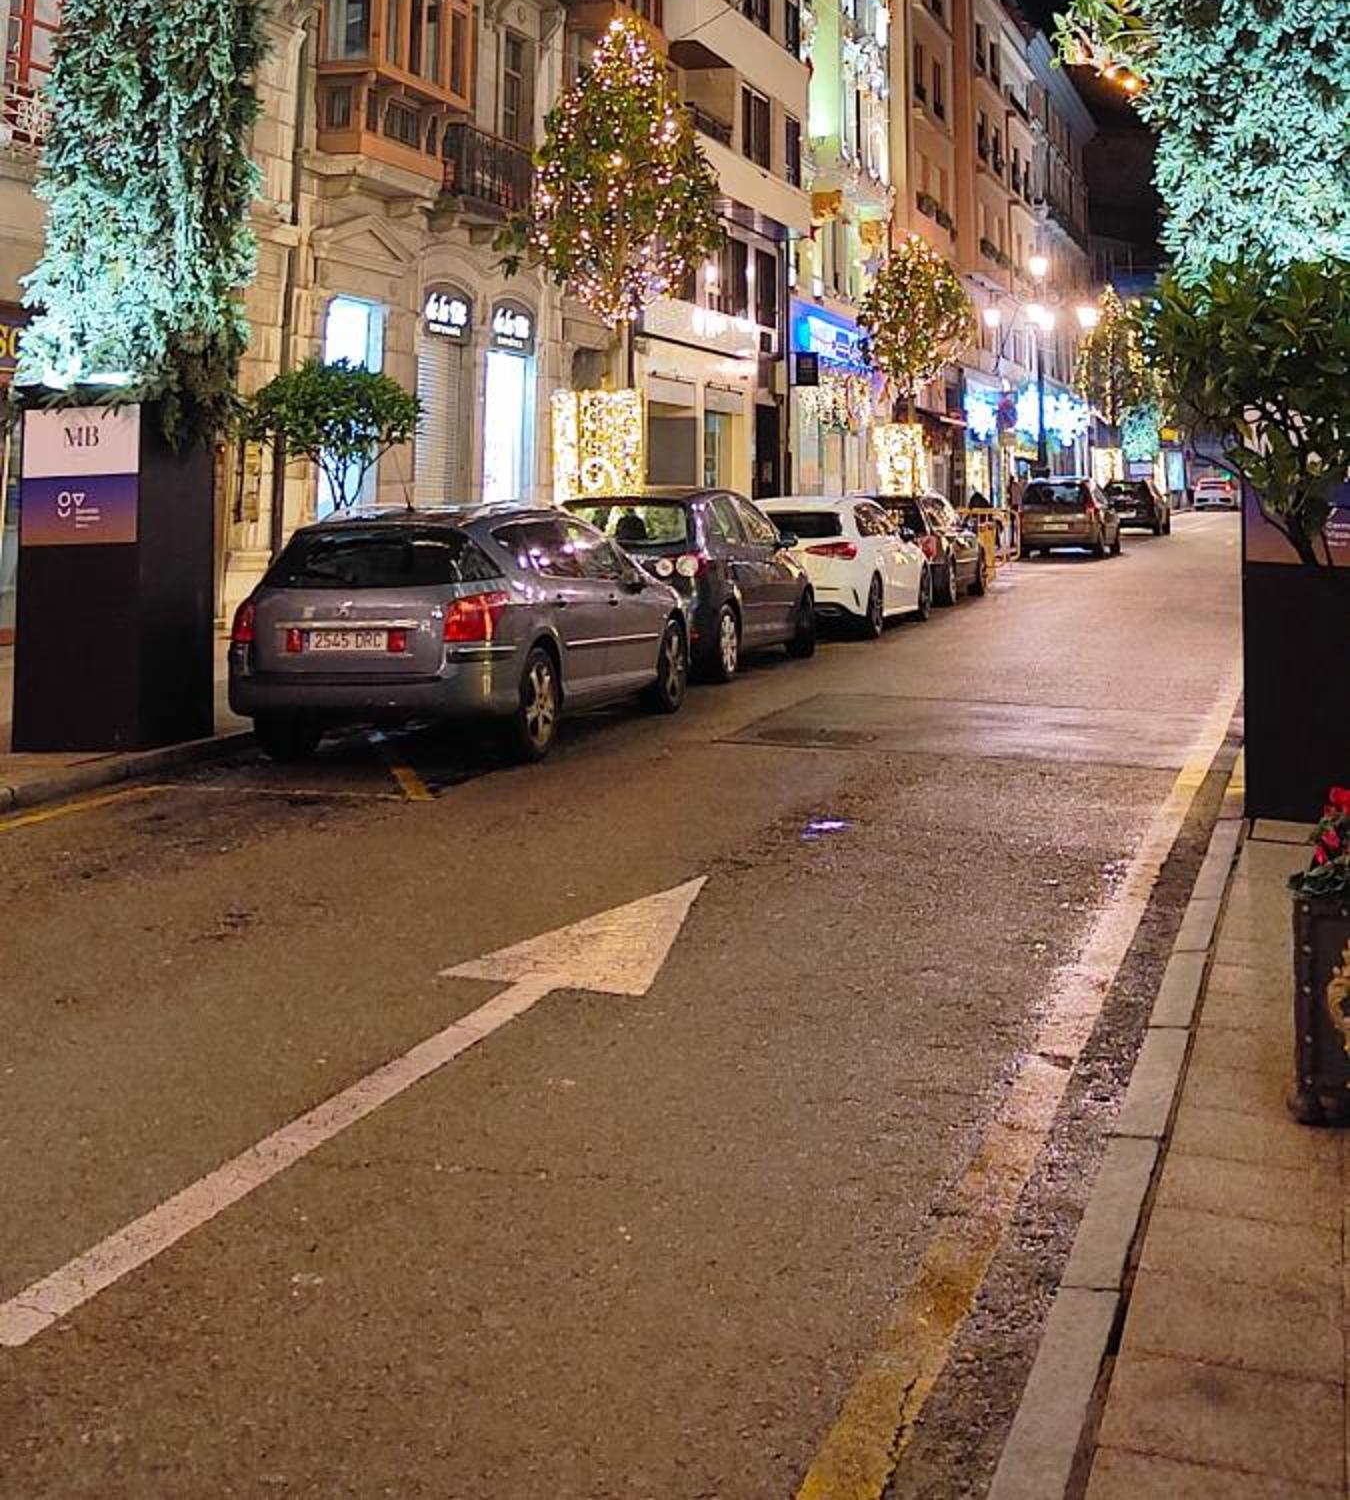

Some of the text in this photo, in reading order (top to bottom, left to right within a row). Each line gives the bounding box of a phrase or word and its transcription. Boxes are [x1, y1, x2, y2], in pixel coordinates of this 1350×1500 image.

[64, 425, 99, 448] MB
[314, 631, 383, 649] 2545 DRC
